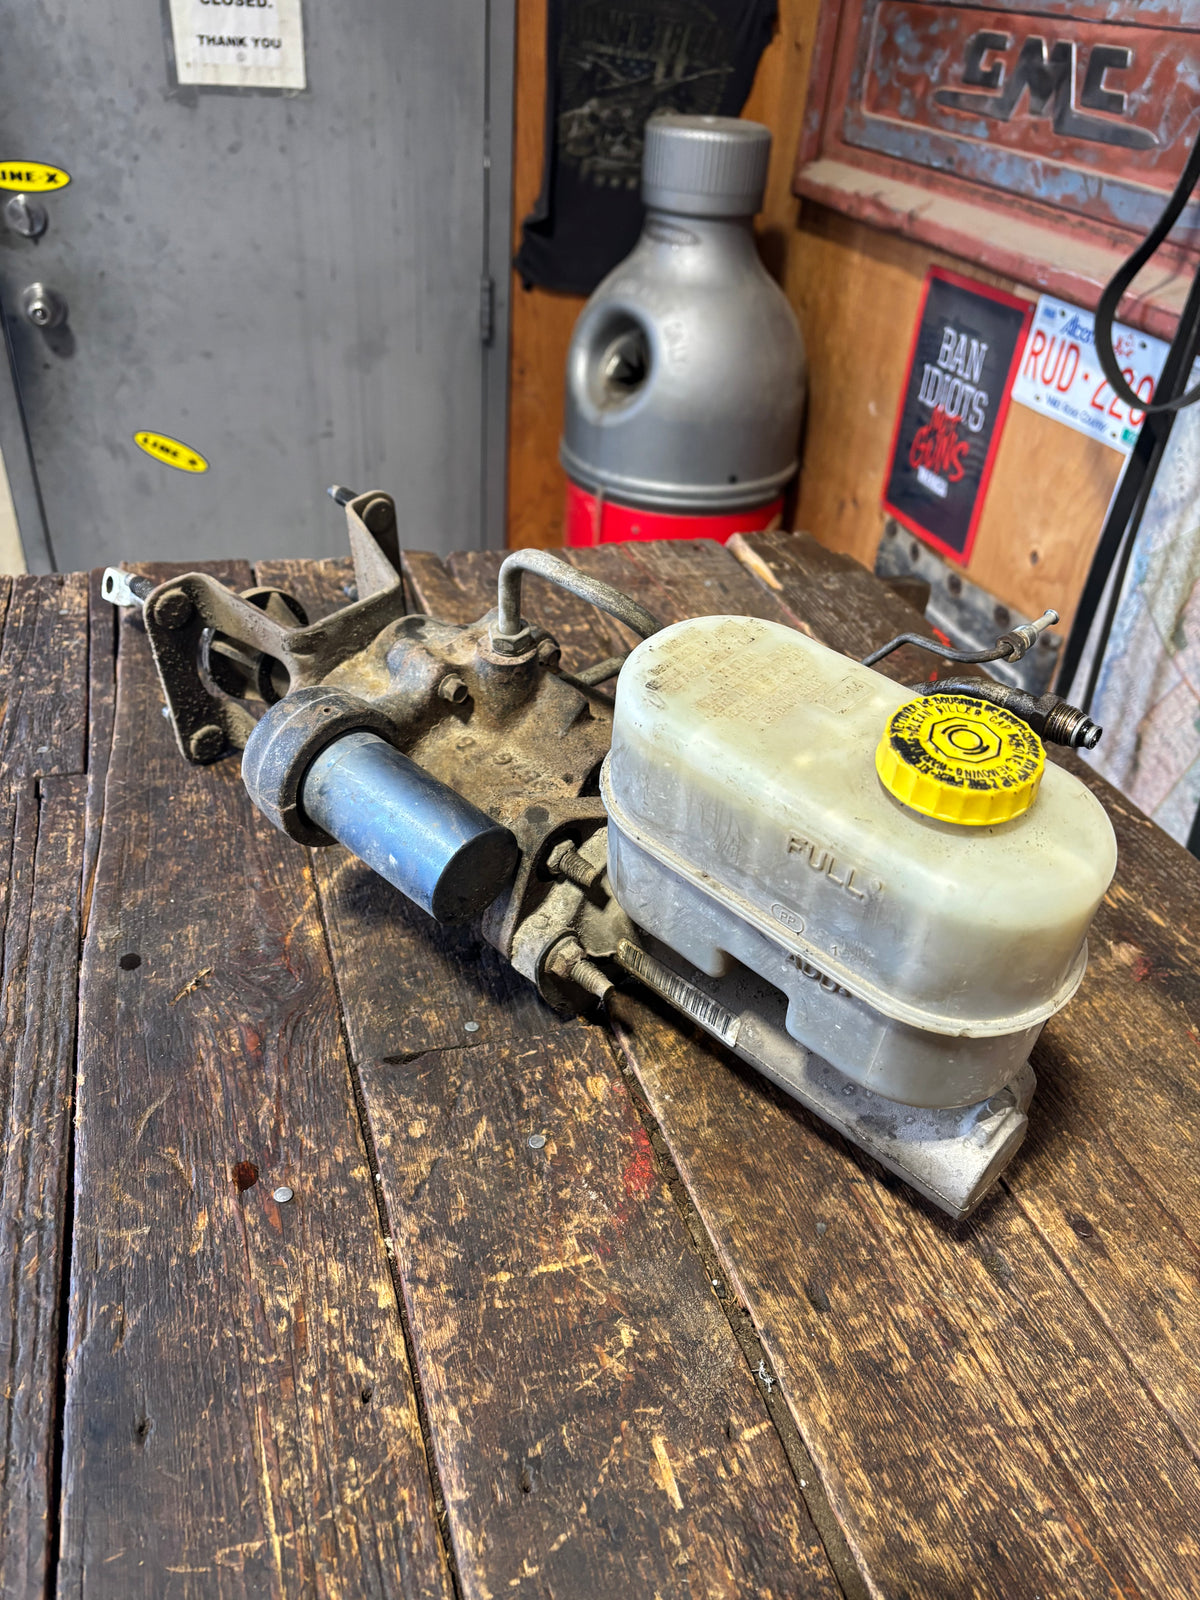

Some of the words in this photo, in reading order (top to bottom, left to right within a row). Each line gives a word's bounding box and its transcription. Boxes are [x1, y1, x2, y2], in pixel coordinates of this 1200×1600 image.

[196, 34, 247, 47] THANK
[250, 36, 282, 49] YOU
[944, 29, 1146, 140] GMC
[0, 170, 58, 183] INE-X
[937, 326, 989, 384] BAN
[917, 363, 990, 433] IDIOTS
[908, 424, 971, 483] GUNS
[936, 704, 982, 716] FILLER
[989, 715, 1012, 730] CAP
[955, 764, 1012, 780] REMOVING
[786, 834, 866, 900] FULL
